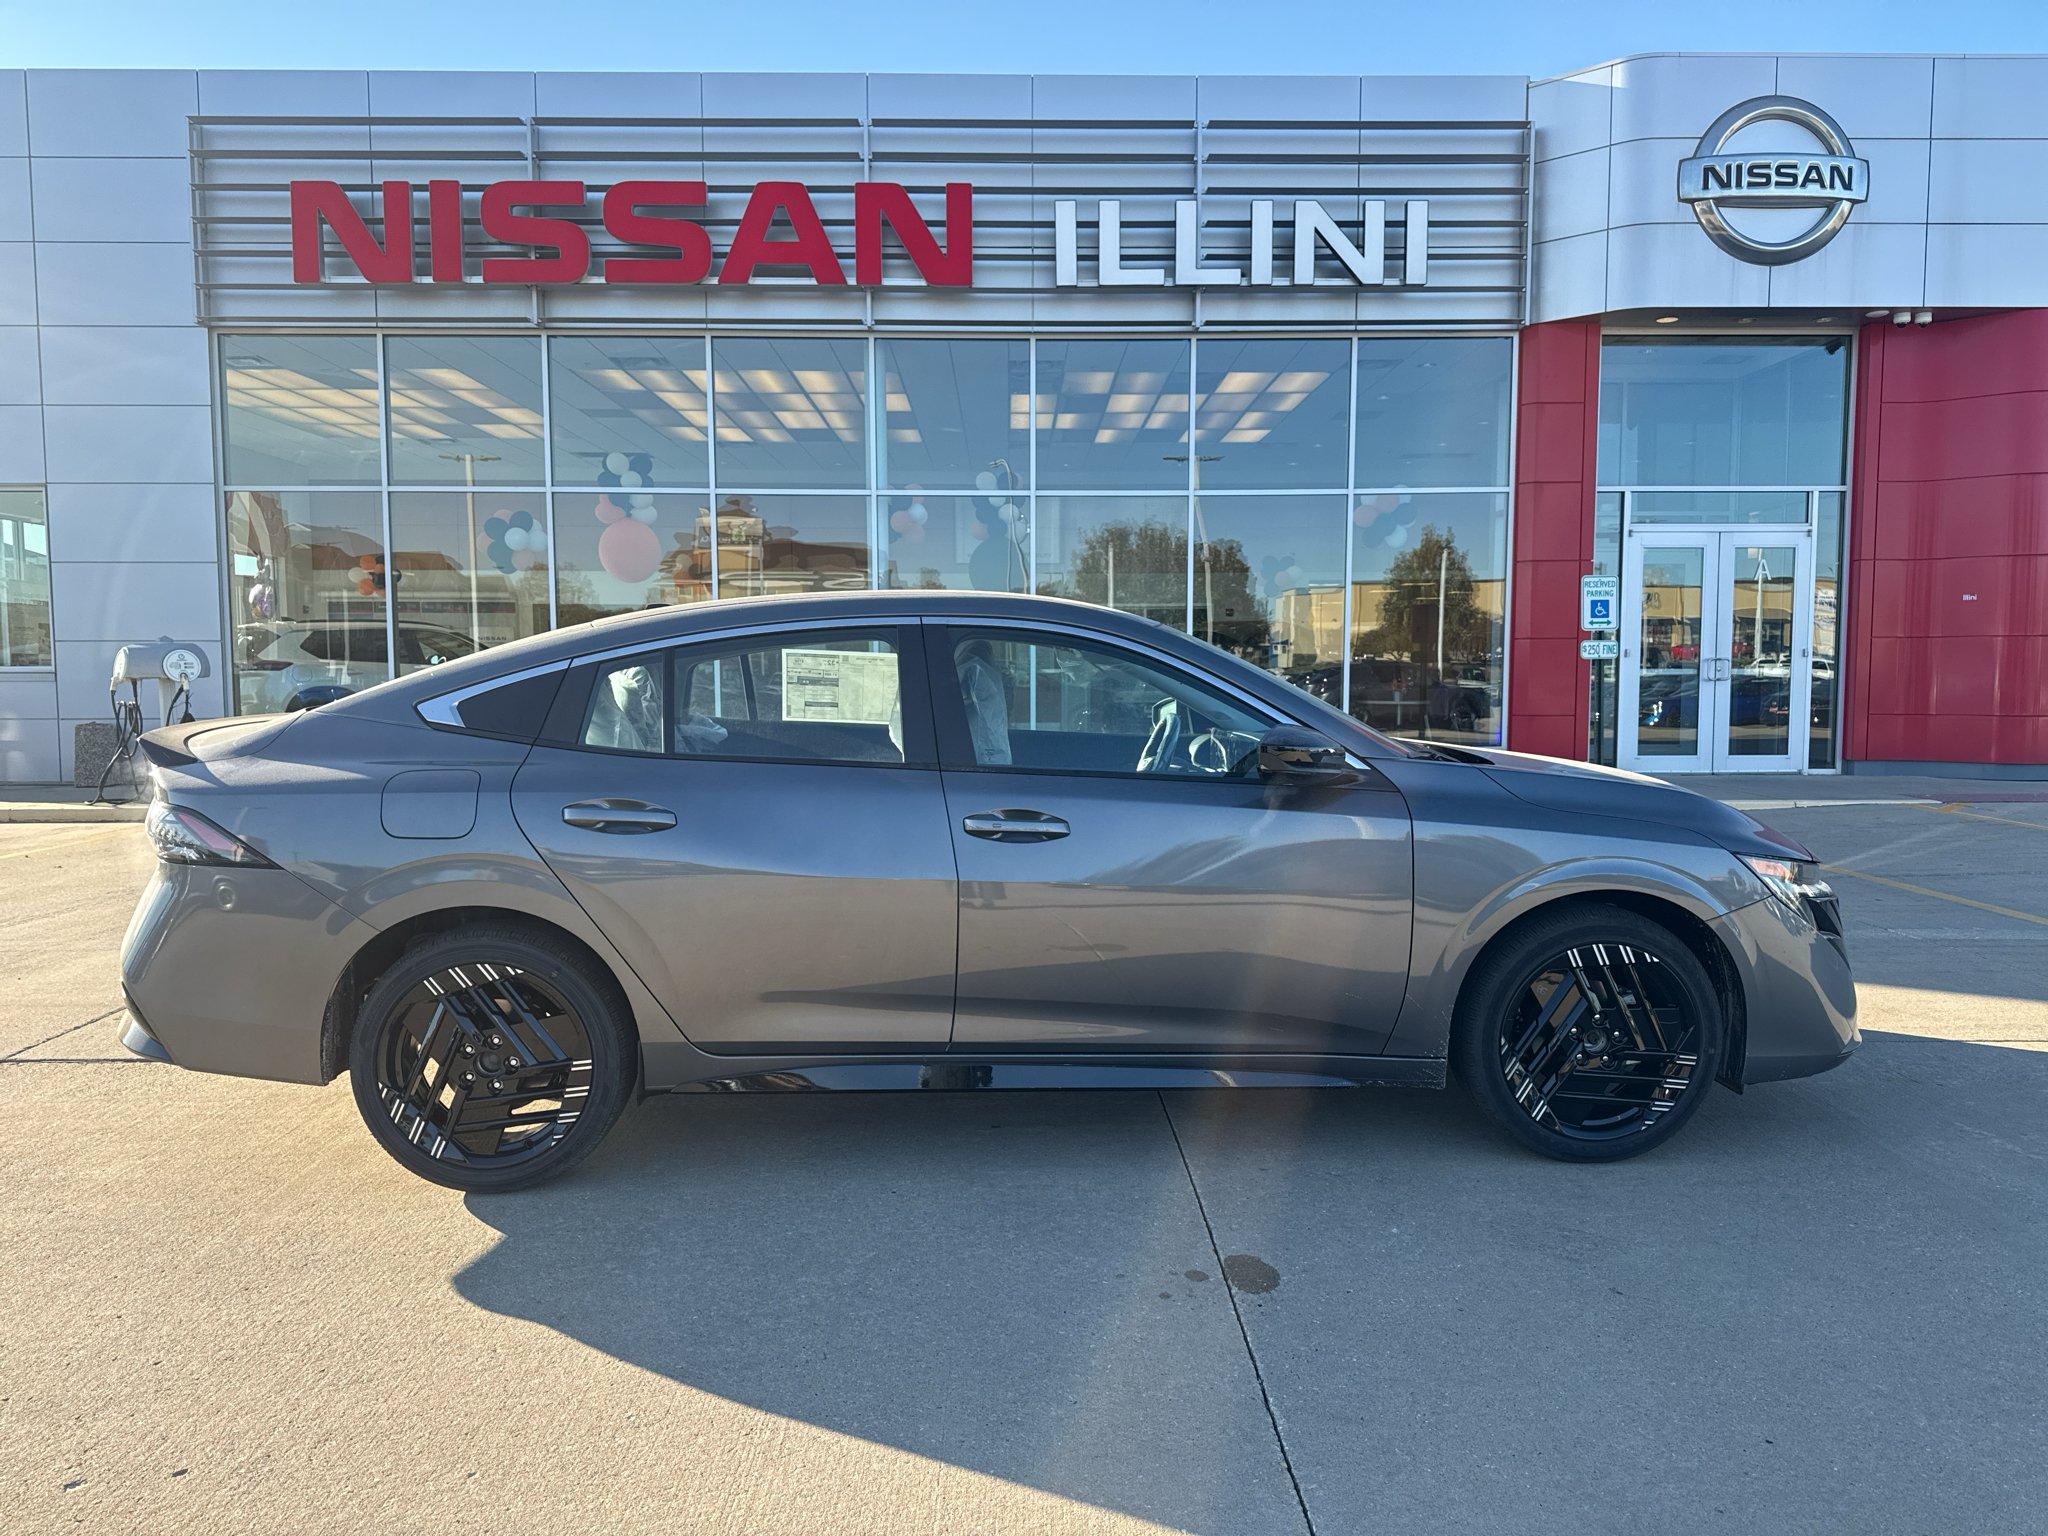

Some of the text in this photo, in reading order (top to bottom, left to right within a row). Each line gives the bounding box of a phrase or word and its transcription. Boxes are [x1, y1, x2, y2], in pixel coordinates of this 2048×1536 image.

[1702, 161, 1854, 191] NISSAN
[290, 180, 1429, 288] NISSAN ILLINI
[1584, 580, 1616, 588] RESERVED
[1586, 589, 1614, 597] PARKING
[1582, 644, 1617, 655] $250 FINE
